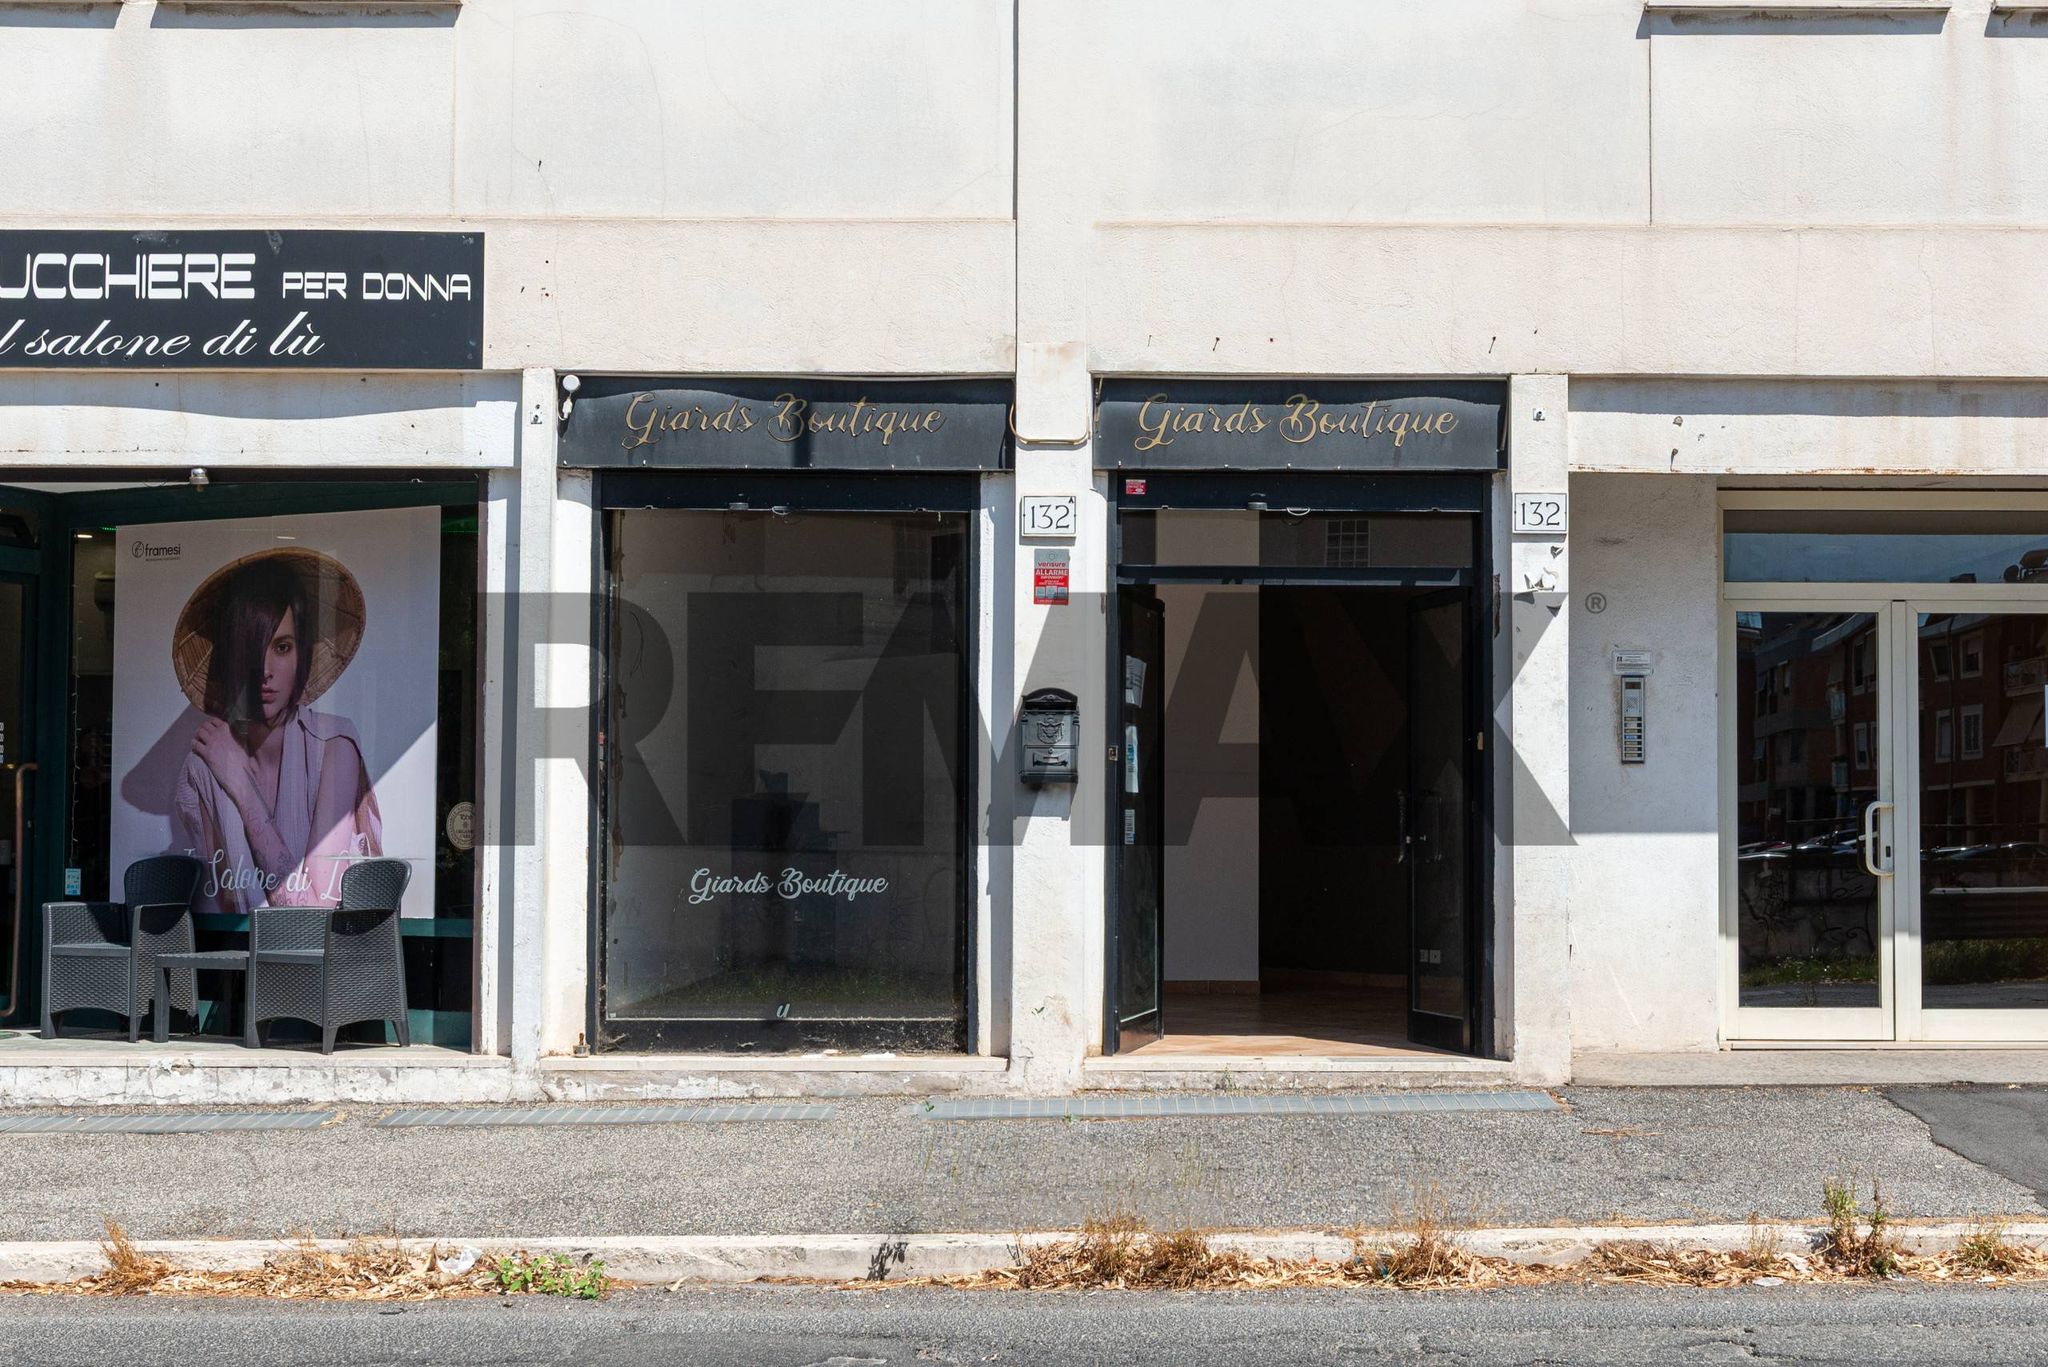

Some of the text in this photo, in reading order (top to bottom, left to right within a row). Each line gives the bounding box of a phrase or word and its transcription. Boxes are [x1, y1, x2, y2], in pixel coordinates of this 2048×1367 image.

[282, 272, 347, 299] PER
[363, 273, 471, 301] DONNA
[25, 319, 191, 356] salone
[203, 319, 257, 356] di
[269, 312, 325, 356] lù
[621, 391, 946, 450] Giards Boutique
[1134, 393, 1459, 451] Giards Boutique
[1029, 504, 1070, 529] 132
[1521, 501, 1561, 526] 132
[145, 543, 181, 557] framesi
[203, 849, 280, 898] Salone
[286, 859, 313, 892] di
[688, 867, 889, 904] Giards Boutique
